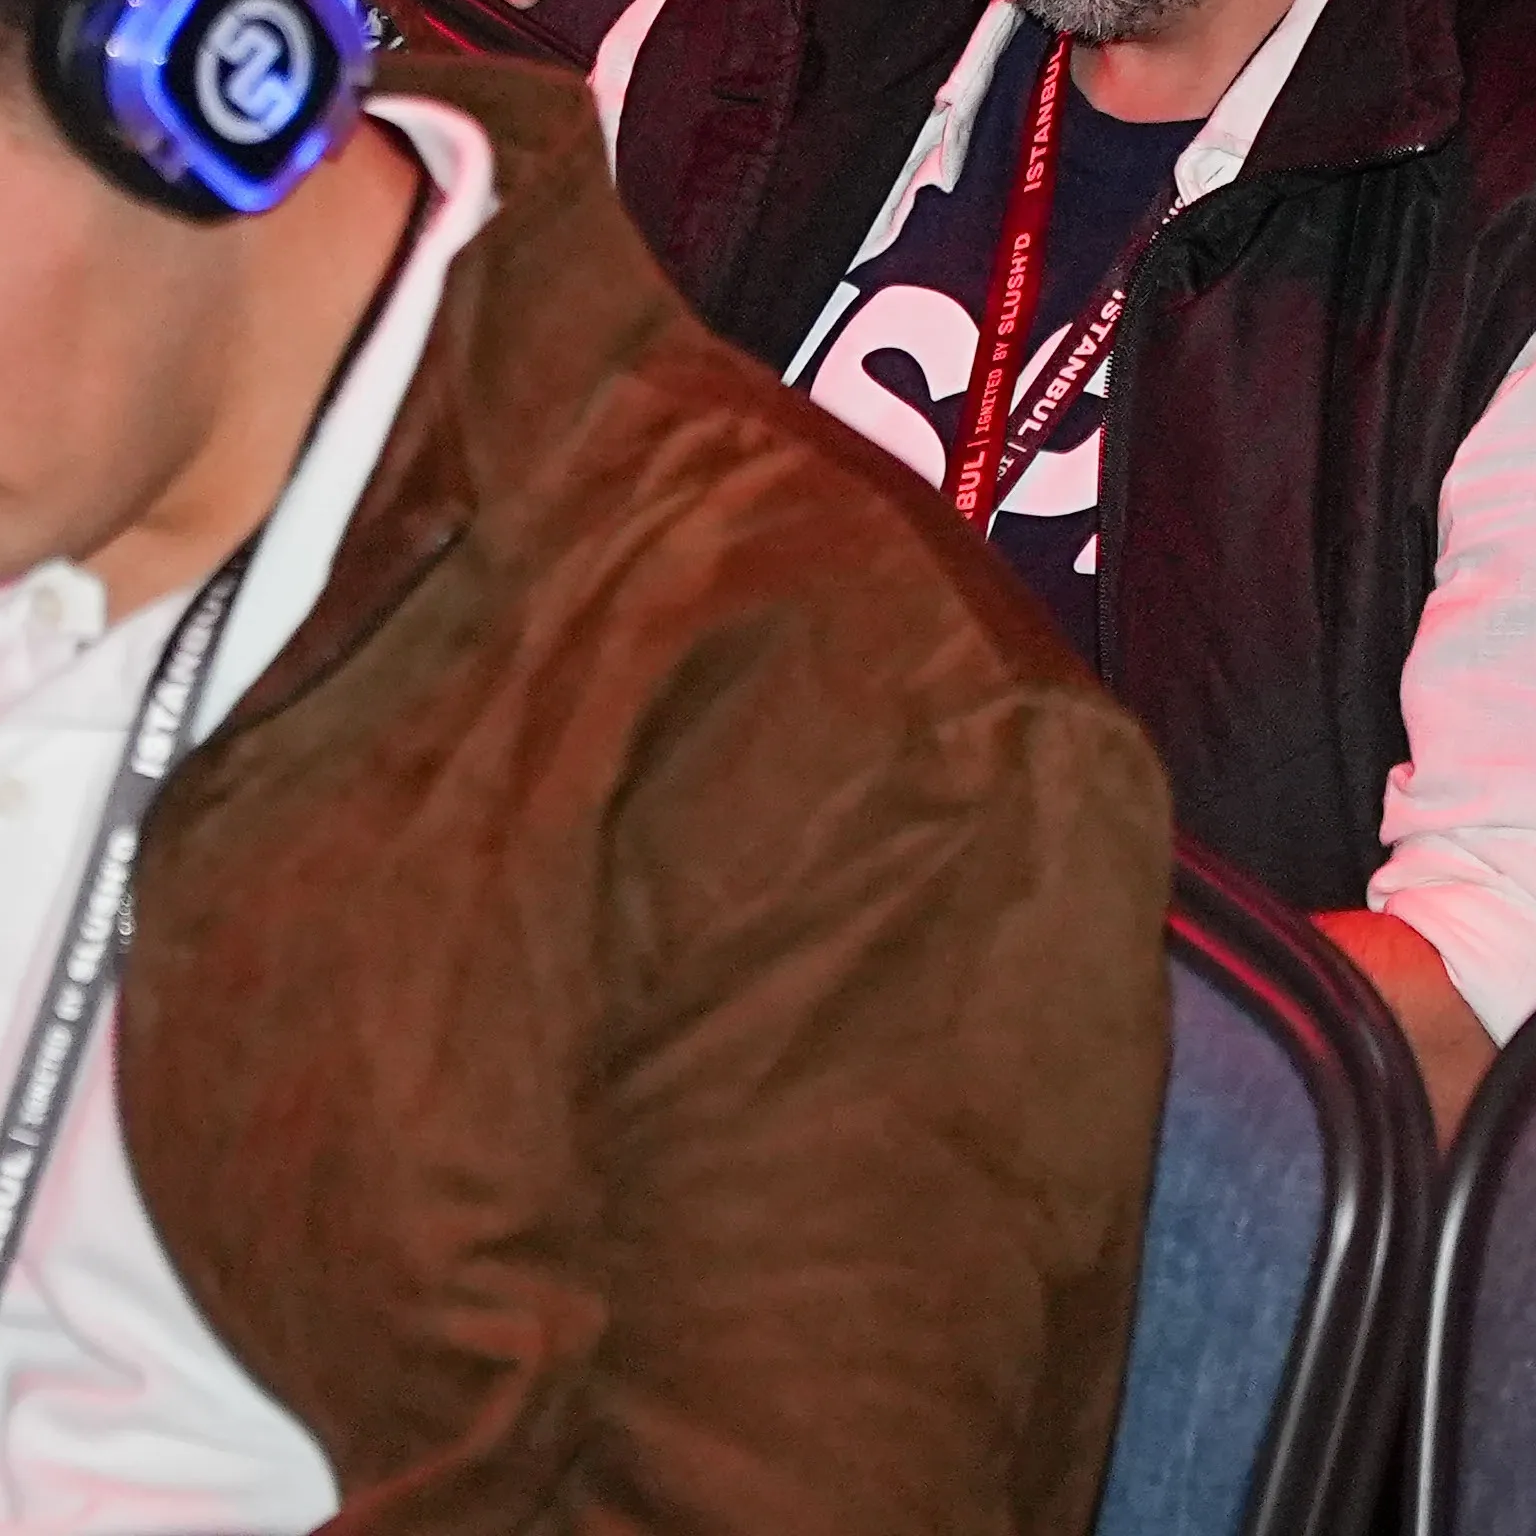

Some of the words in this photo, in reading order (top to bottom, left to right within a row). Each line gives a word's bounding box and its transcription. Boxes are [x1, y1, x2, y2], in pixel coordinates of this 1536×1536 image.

[1023, 40, 1065, 193] ISTANBUL
[997, 231, 1032, 336] SLUSH'D
[992, 341, 1010, 362] BY
[974, 368, 1004, 435] IGNITED
